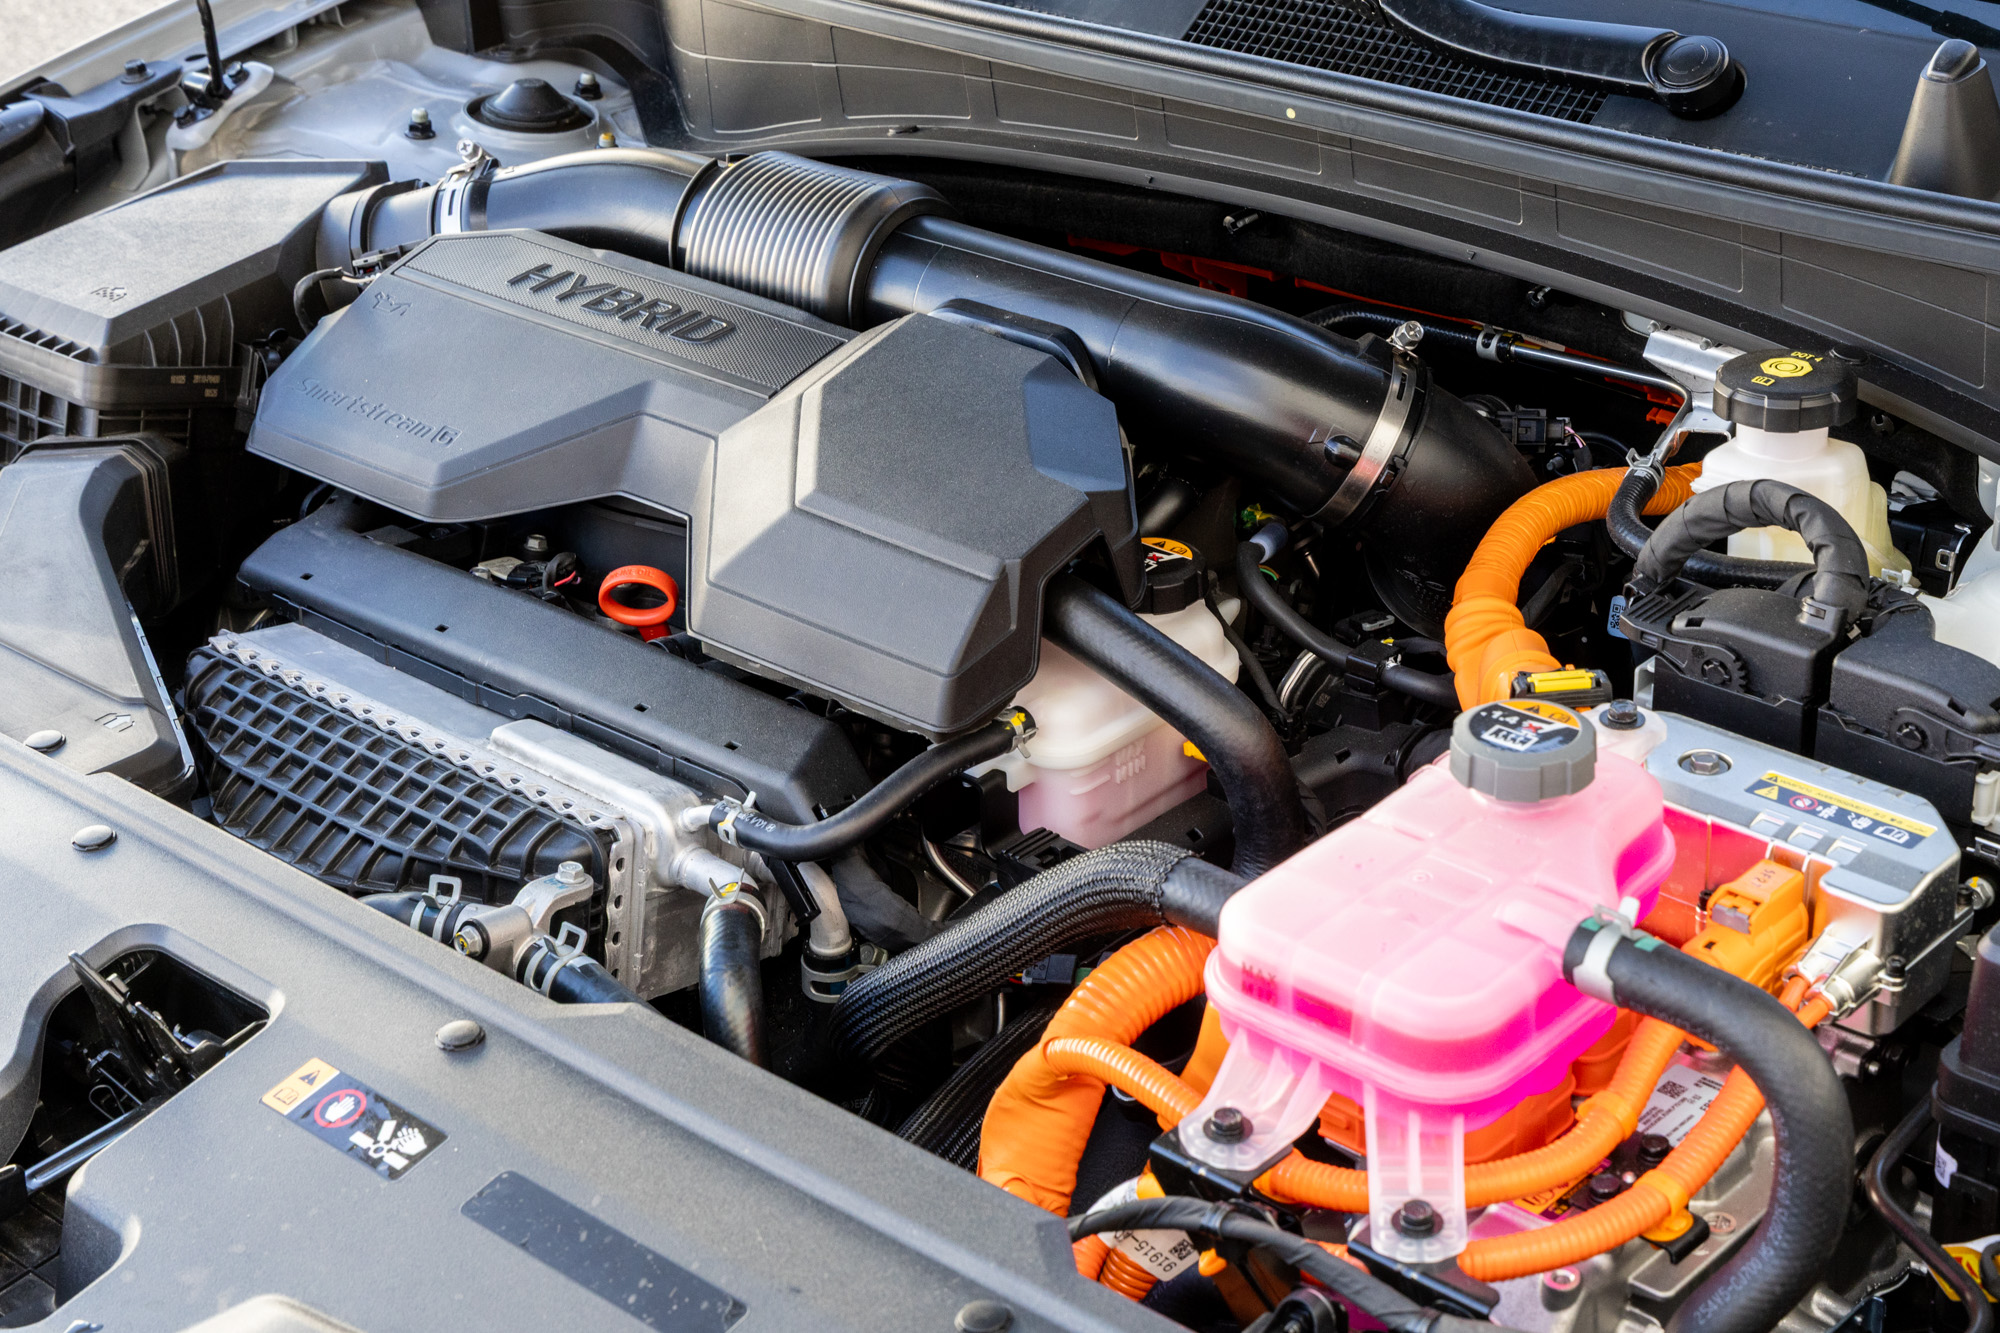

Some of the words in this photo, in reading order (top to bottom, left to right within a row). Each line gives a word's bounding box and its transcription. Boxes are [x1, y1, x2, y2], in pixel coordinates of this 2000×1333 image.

[505, 262, 736, 345] HYBRID
[1790, 351, 1815, 360] DOT
[296, 377, 437, 440] Smartstream
[1115, 755, 1146, 785] MIN
[1241, 961, 1277, 986] MAX
[1241, 980, 1278, 1007] MIN
